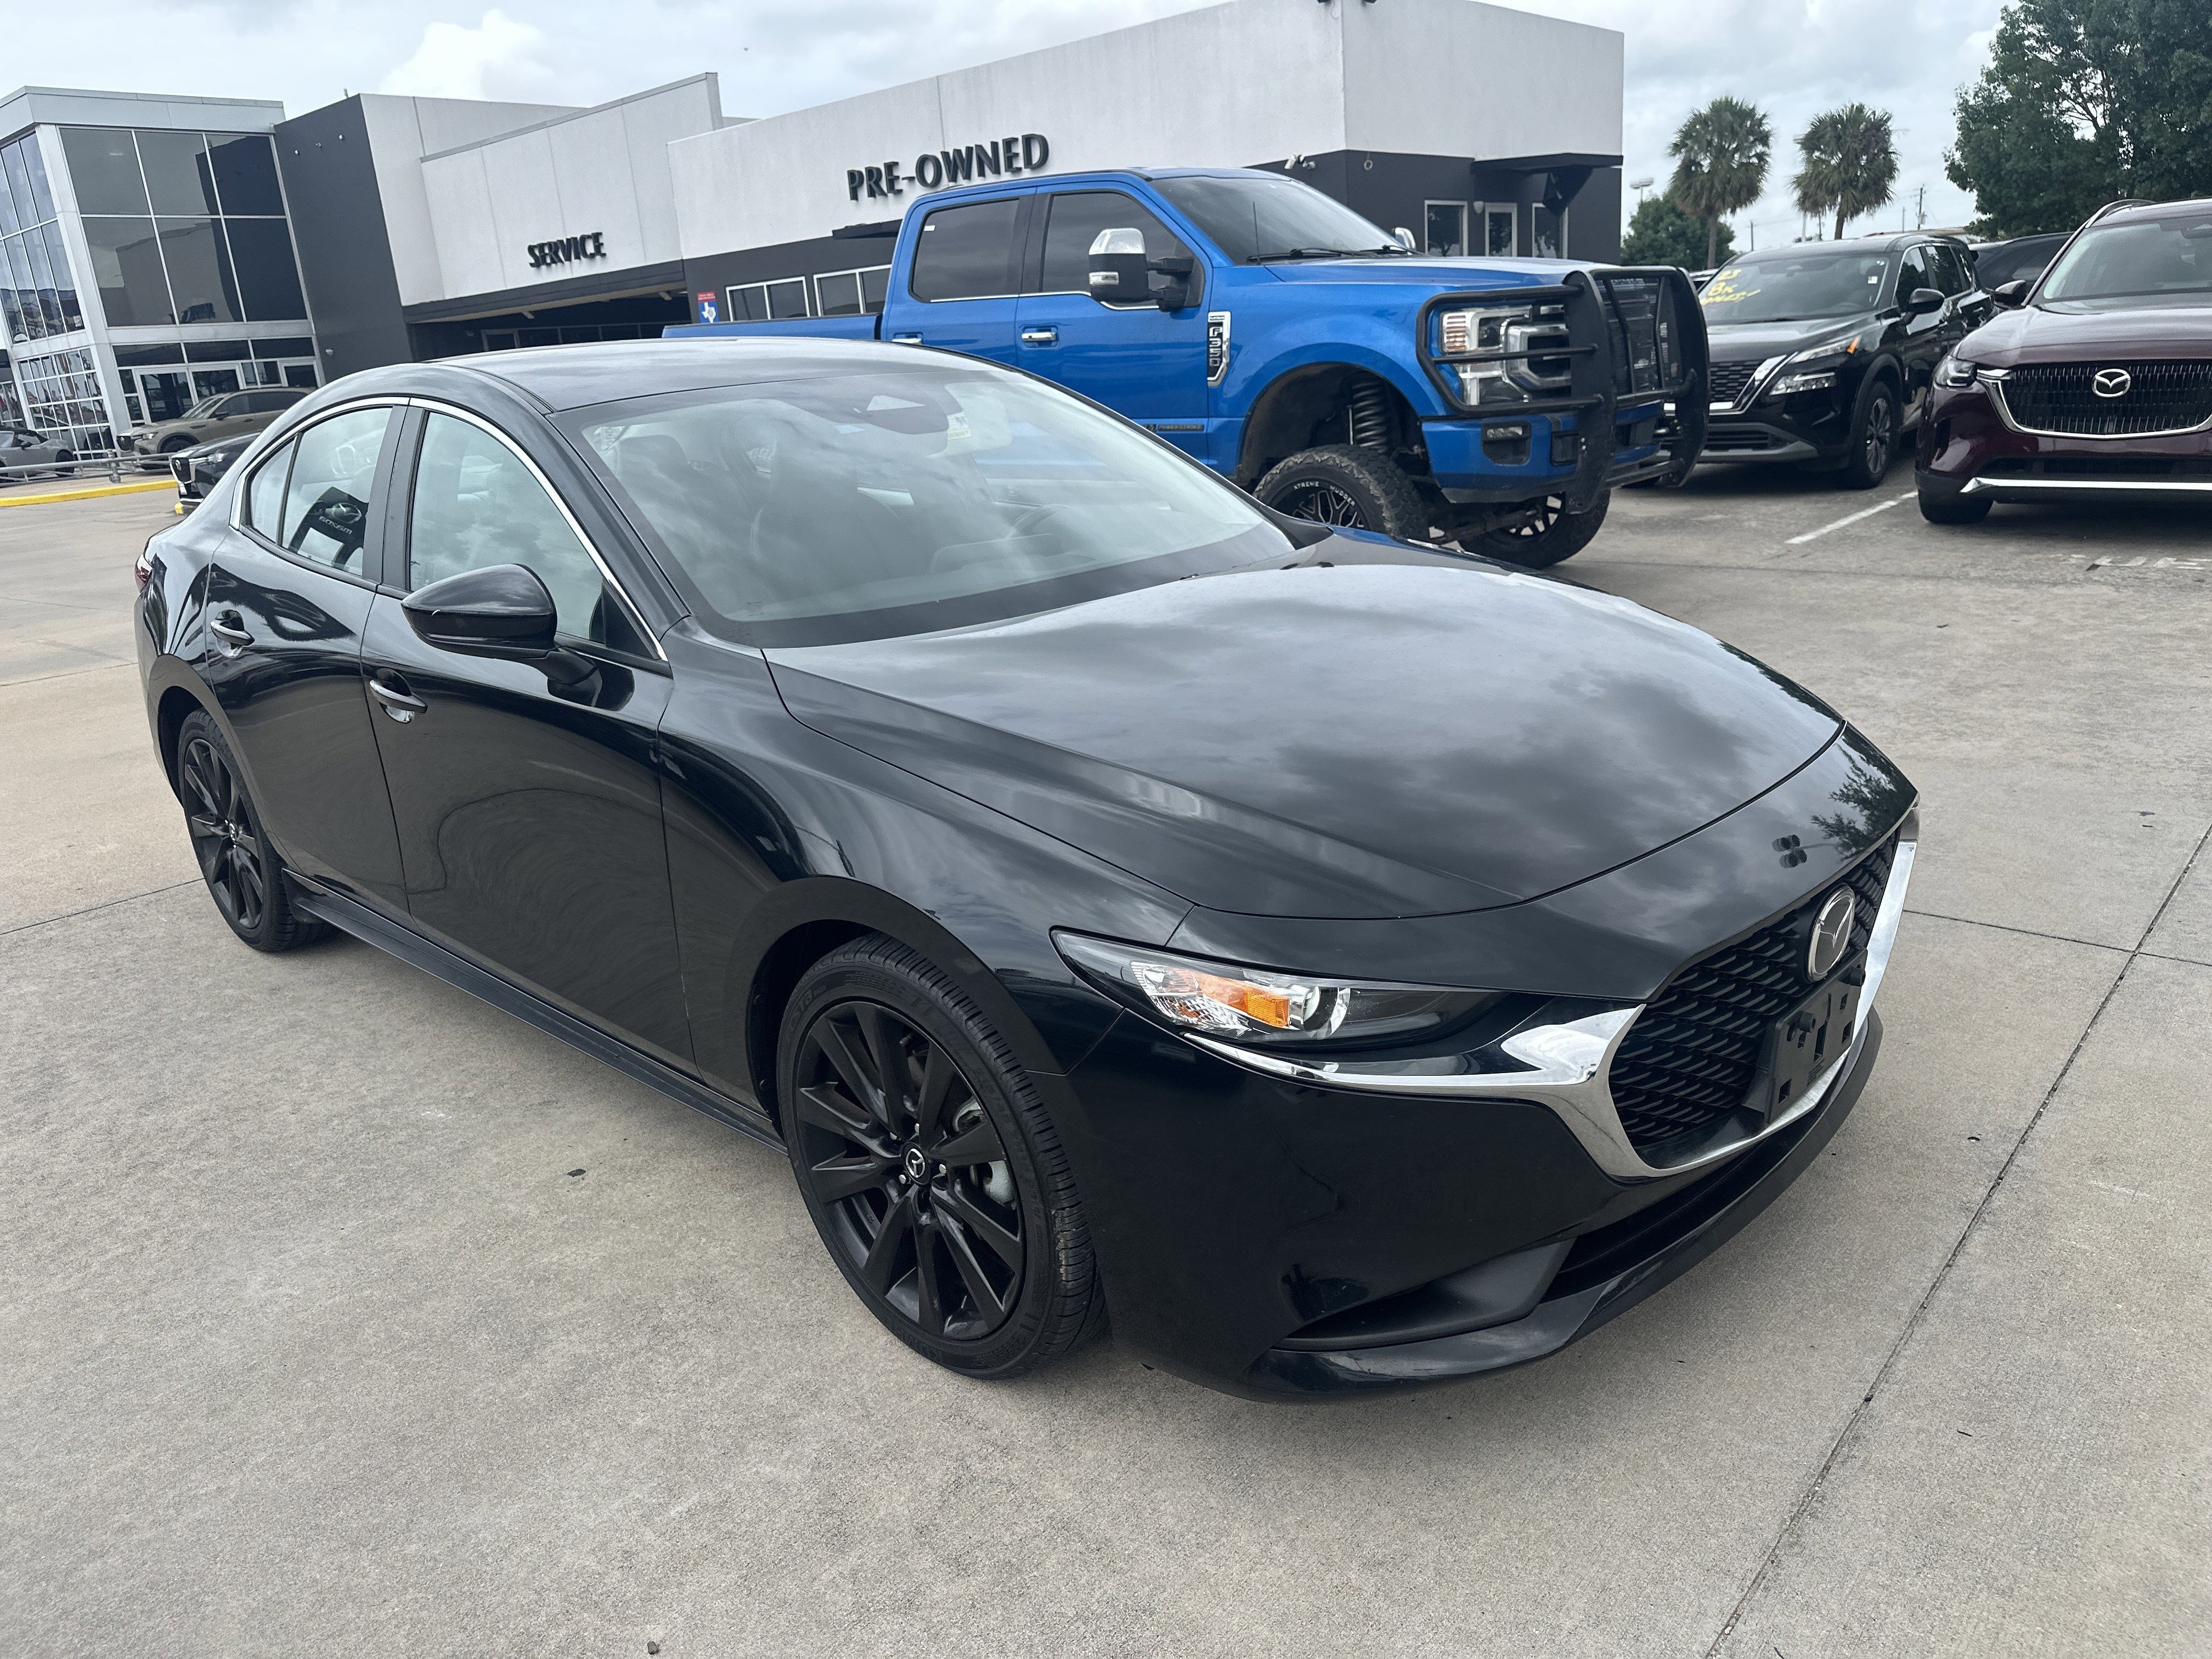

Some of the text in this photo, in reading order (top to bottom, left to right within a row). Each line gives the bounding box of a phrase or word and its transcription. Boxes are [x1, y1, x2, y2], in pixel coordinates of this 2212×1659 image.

[847, 133, 1049, 201] PRE-OWNED
[528, 232, 606, 268] SERVICE
[1209, 326, 1222, 366] F350
[1294, 481, 1355, 506] XTREME MUDDER
